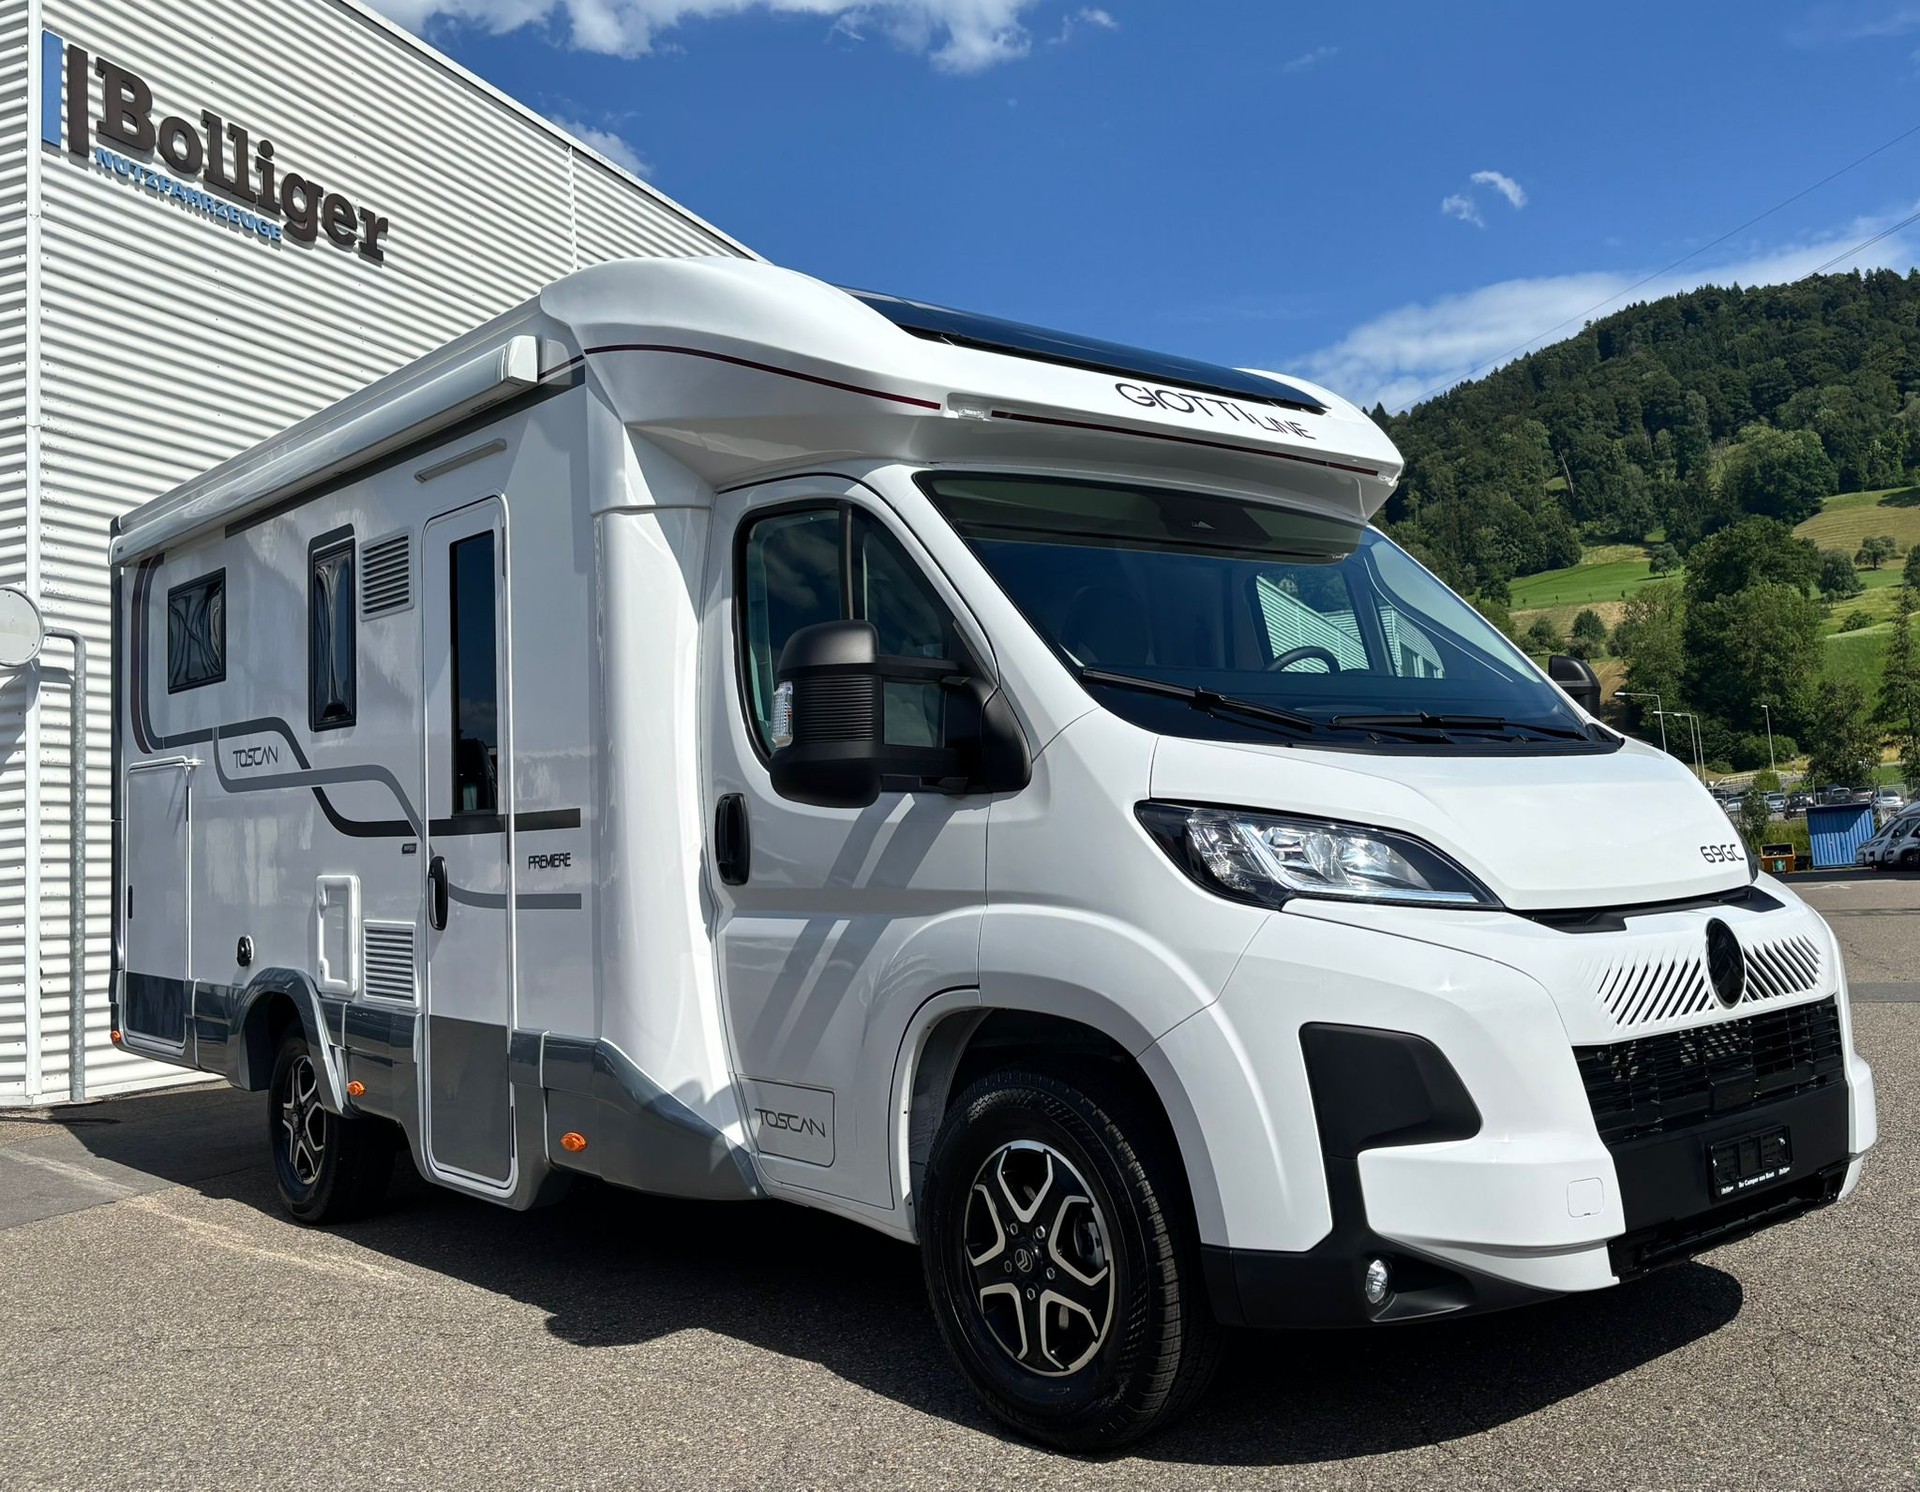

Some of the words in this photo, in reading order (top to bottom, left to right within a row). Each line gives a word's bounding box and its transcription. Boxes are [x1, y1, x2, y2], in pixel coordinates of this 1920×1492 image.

[95, 56, 389, 263] Bolliger
[95, 147, 282, 242] NUTZFAHRZEUGE
[232, 745, 279, 769] TOSCAN
[528, 852, 572, 870] PREMIERE
[754, 1107, 826, 1138] TOSCAN
